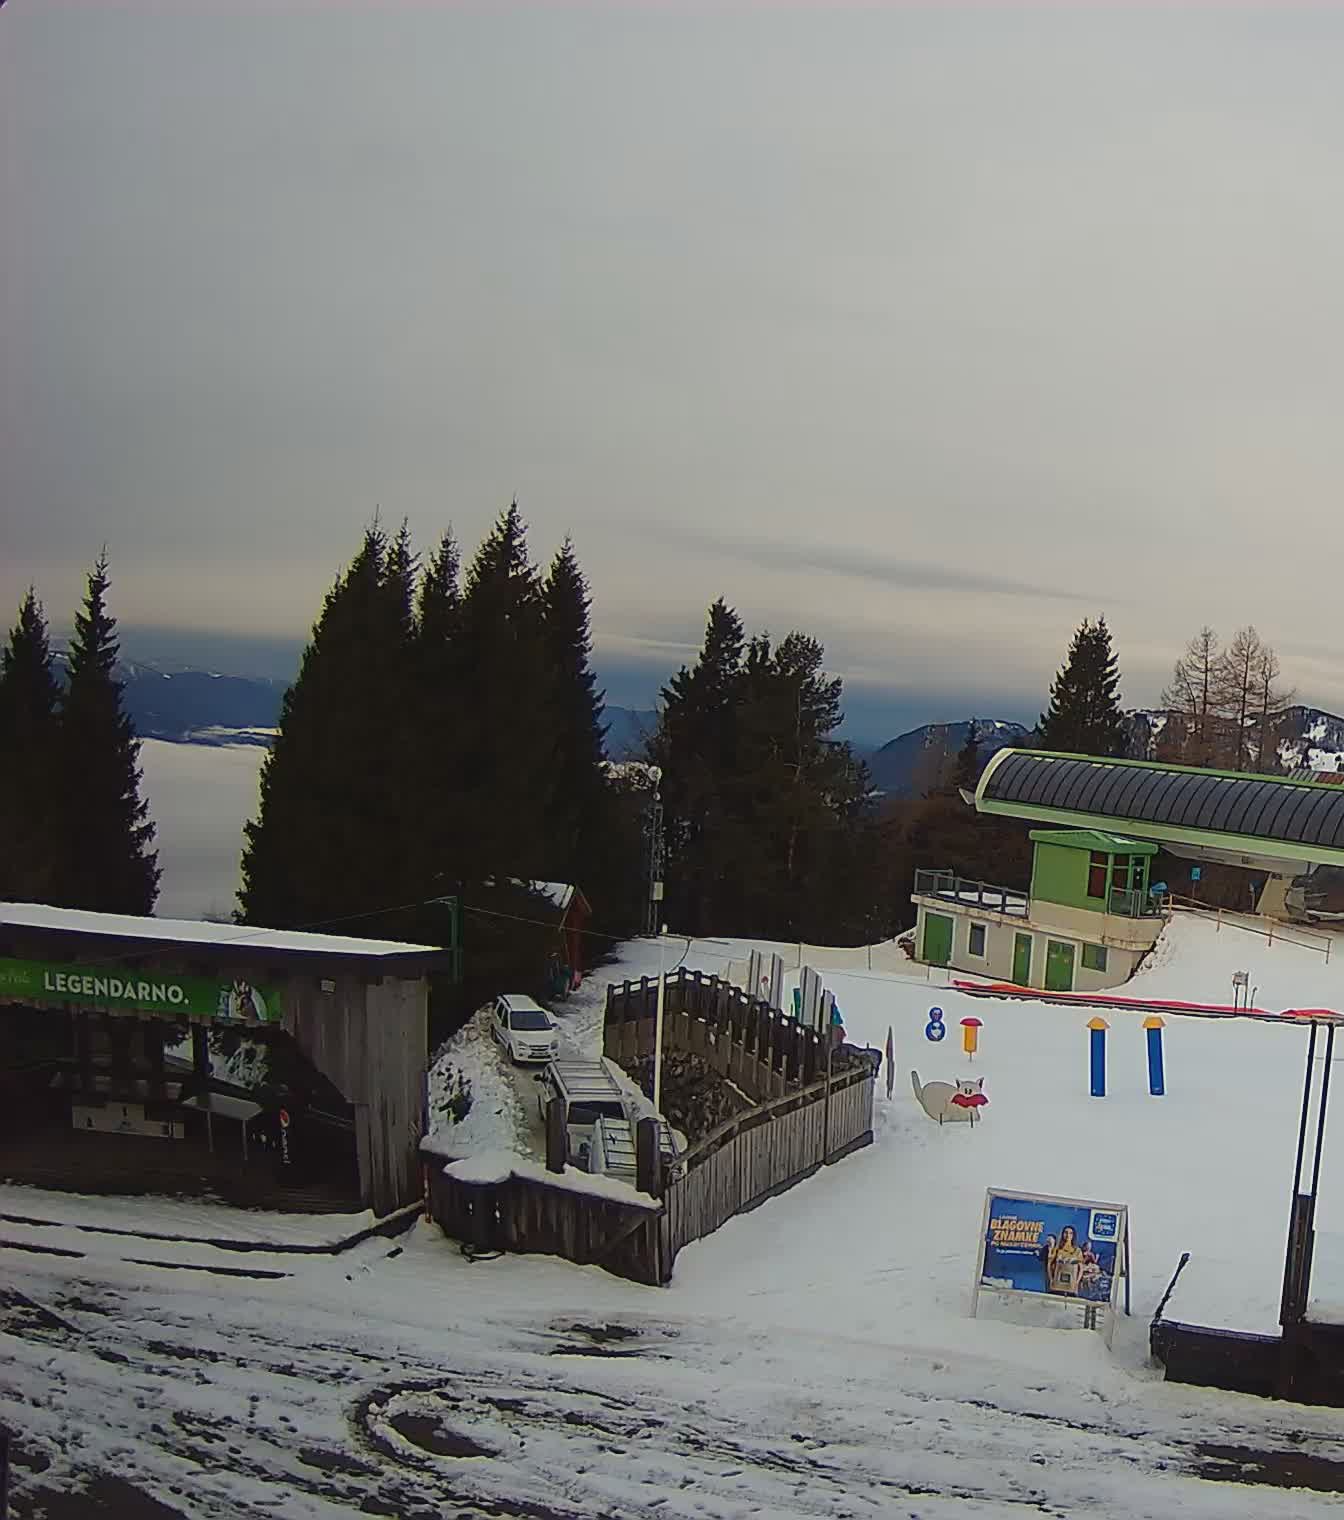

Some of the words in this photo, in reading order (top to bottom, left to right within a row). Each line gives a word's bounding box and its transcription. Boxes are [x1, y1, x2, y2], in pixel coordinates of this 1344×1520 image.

[44, 971, 190, 1005] LEGENDARNO.
[990, 1218, 1045, 1233] BLAGOVNE
[993, 1230, 1040, 1243] ZNAMKE
